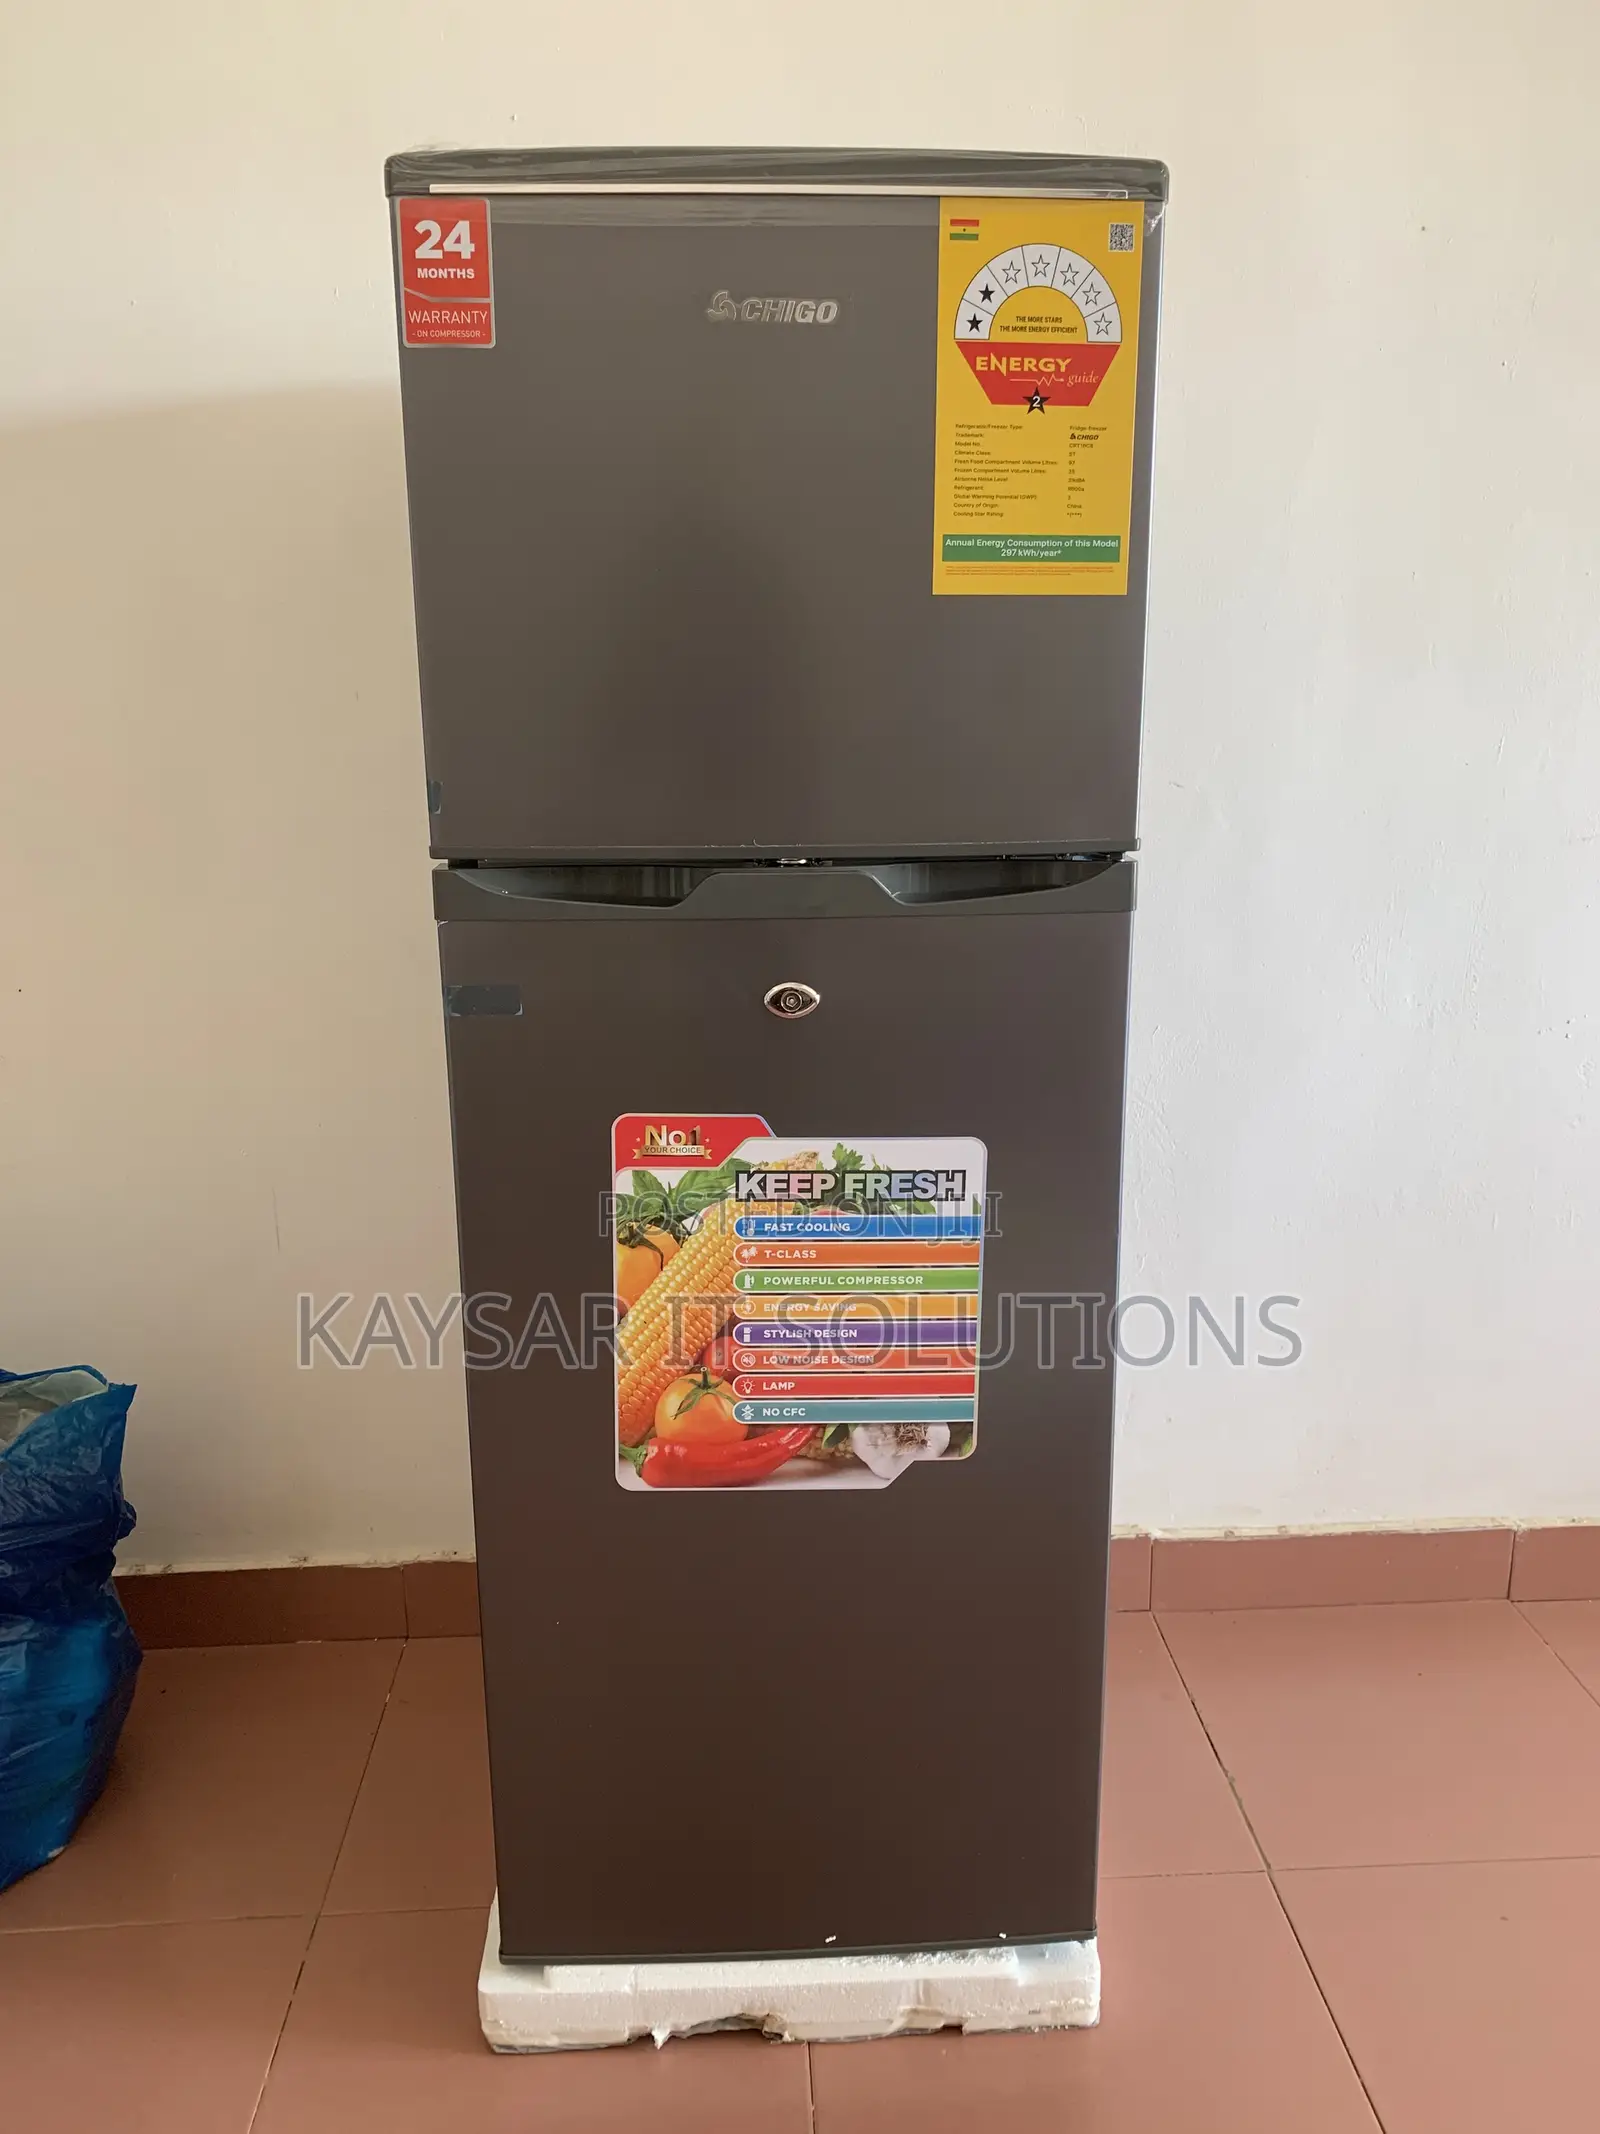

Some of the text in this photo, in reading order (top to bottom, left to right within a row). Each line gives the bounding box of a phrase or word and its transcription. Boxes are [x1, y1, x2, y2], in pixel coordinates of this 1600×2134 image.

[414, 219, 475, 259] 24
[417, 267, 475, 279] MONTHS
[408, 310, 488, 324] WARRANTY
[741, 299, 838, 324] CHIGO
[1016, 315, 1026, 323] THE
[1044, 316, 1063, 324] STARS
[417, 329, 481, 338] ON COMPRESSOR
[999, 325, 1078, 334] THE MORE ENERGY EFFICIENT
[975, 352, 1072, 376] ENERGY
[1066, 370, 1099, 387] guide
[1032, 395, 1041, 408] 2
[945, 538, 1119, 549] Annual Energy Consumption of this Model
[1000, 549, 1017, 558] 297
[644, 1146, 702, 1154] YOUR CHOICE
[735, 1170, 967, 1202] KEEP FRESH
[763, 1222, 851, 1233] FAST COOLING
[763, 1249, 817, 1260] T-CLASS
[763, 1275, 924, 1286] POWERFUL COMPRESSOR
[763, 1302, 858, 1313] ENERGY SAVING
[763, 1328, 858, 1339] STYLISH DESIGN
[762, 1354, 875, 1365] LOW NOISE DESIGN
[762, 1381, 796, 1392] LAMP
[762, 1407, 807, 1418] NO CFC
